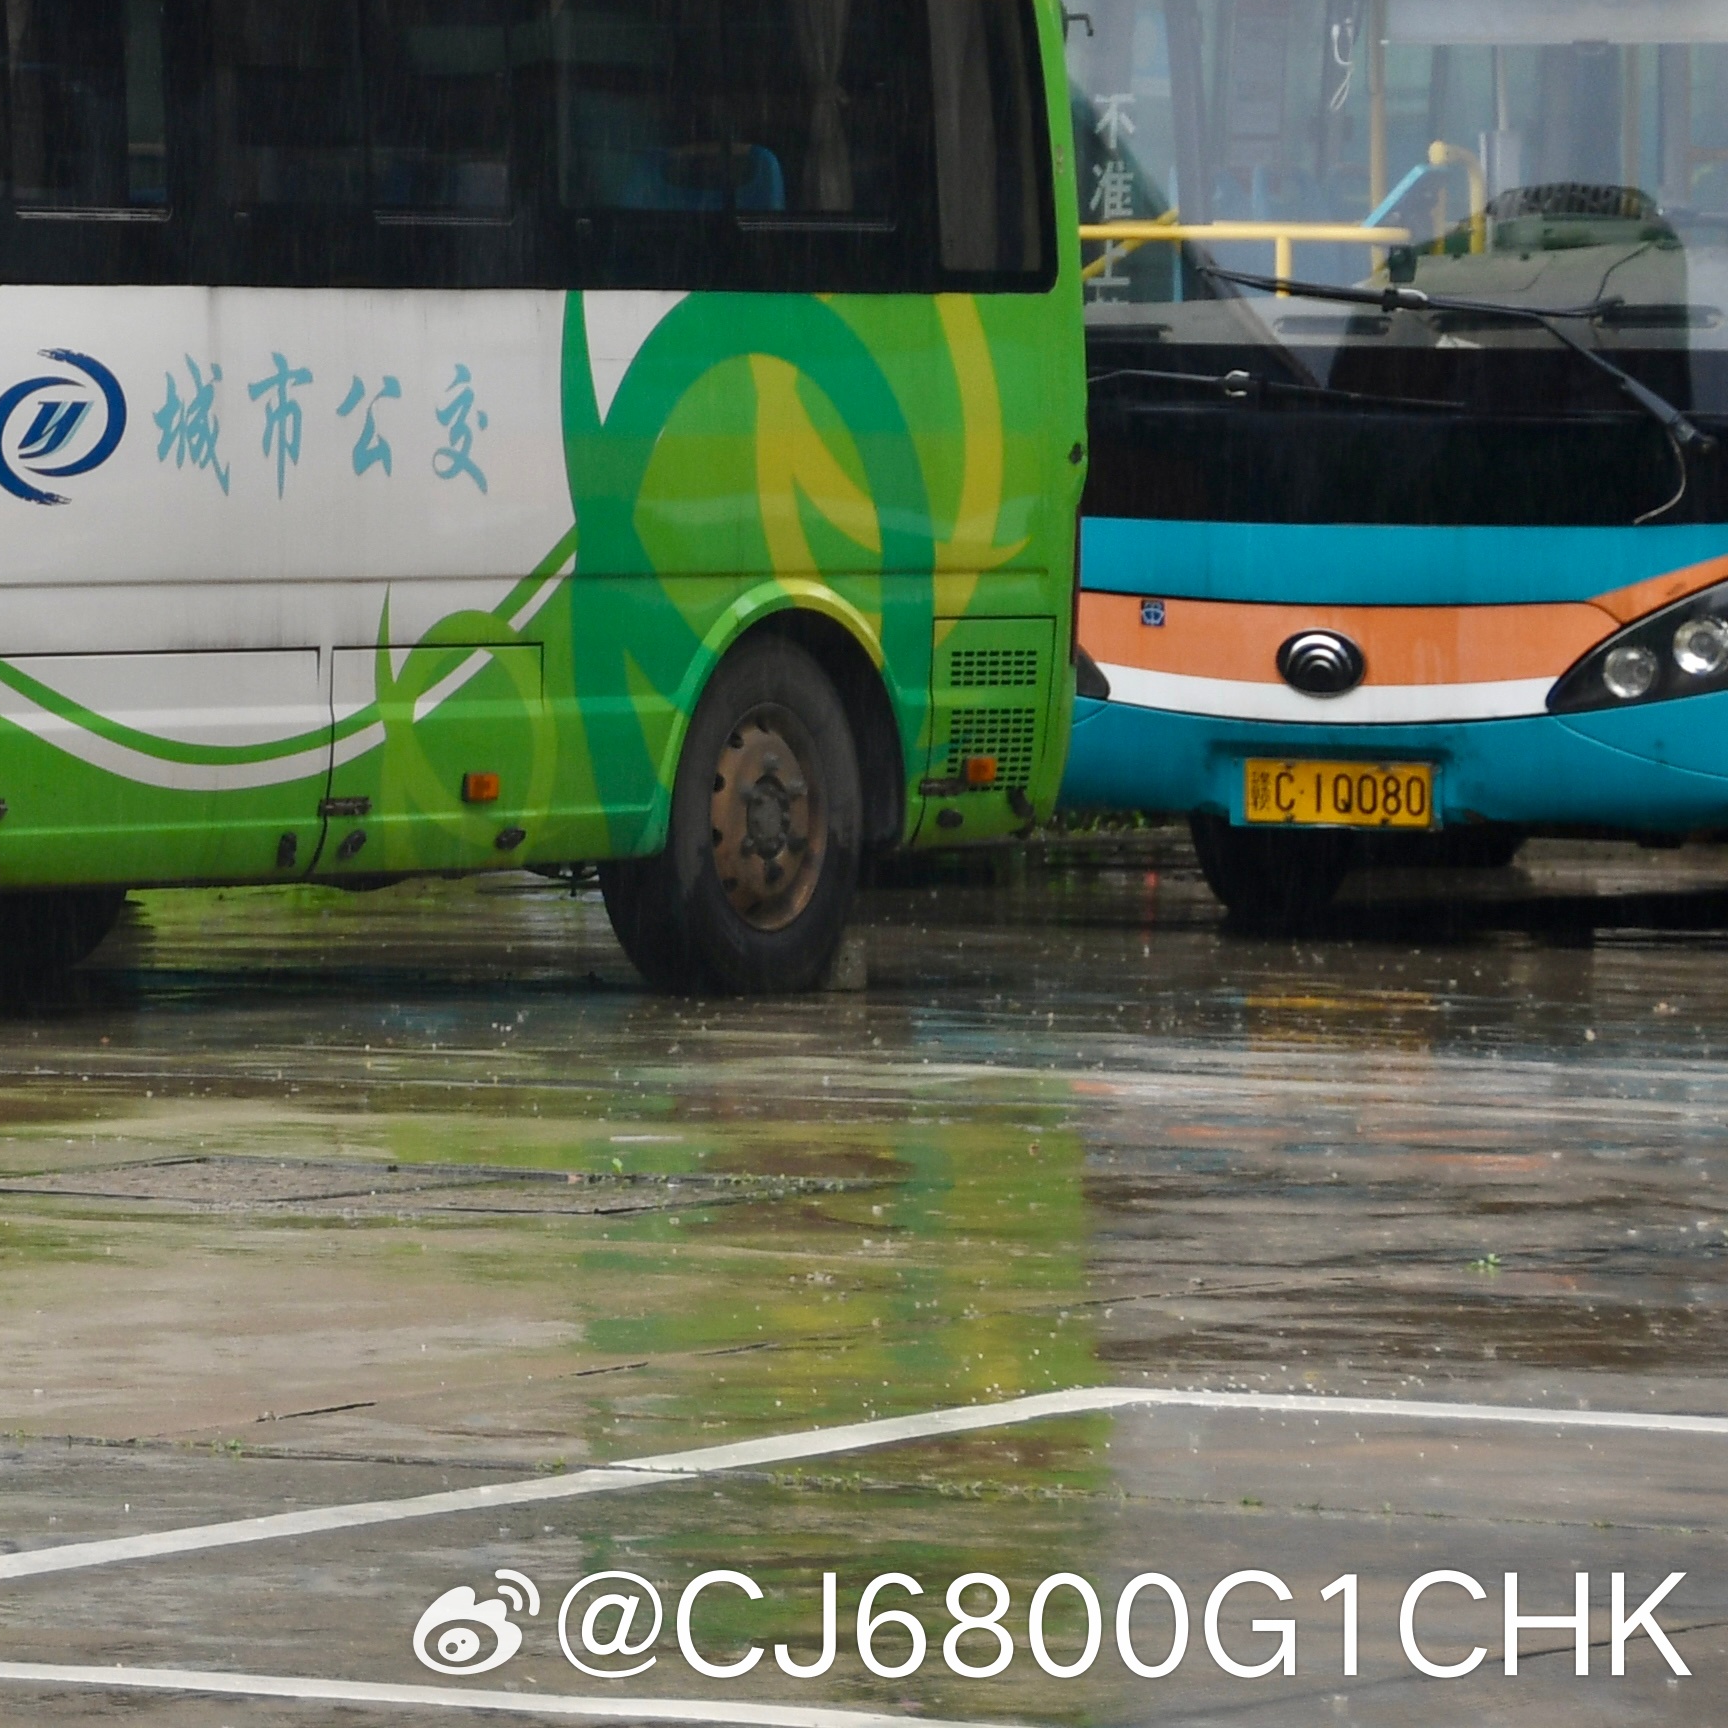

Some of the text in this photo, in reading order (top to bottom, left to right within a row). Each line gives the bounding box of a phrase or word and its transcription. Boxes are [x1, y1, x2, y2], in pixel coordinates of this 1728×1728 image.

[1085, 93, 1136, 306] 不准上
[153, 351, 489, 500] 城市公交
